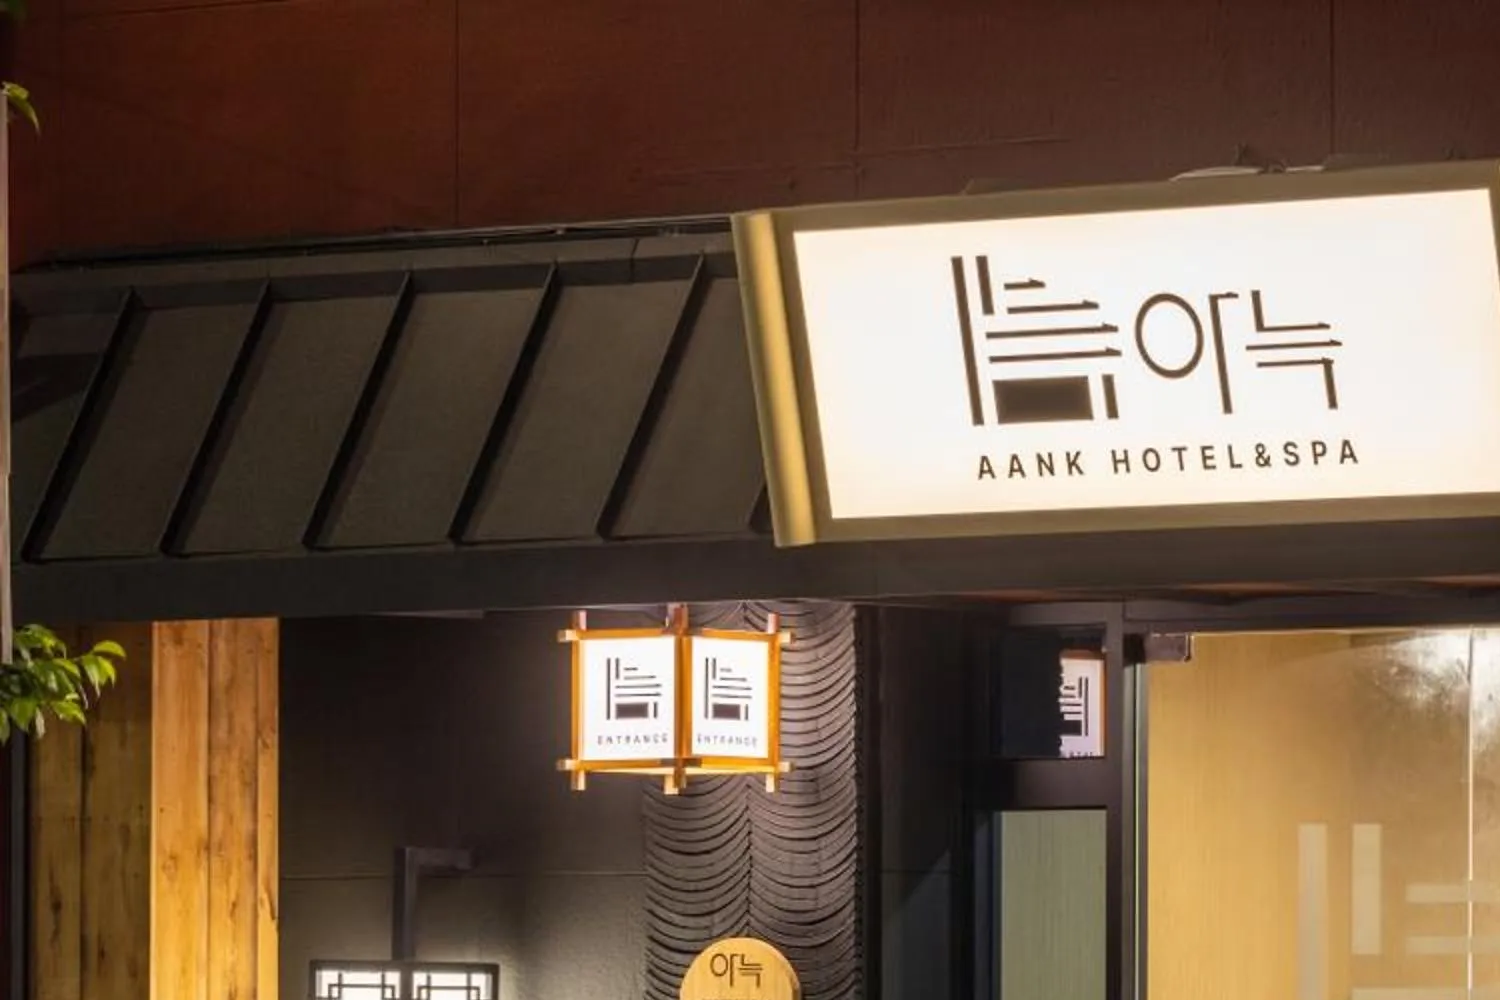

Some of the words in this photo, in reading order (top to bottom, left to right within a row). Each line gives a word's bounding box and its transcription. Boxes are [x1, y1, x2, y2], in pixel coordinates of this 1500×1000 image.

[1135, 290, 1342, 414] 아늑
[977, 450, 1084, 480] AANK
[1111, 439, 1358, 475] HOTEL&SPA
[597, 732, 669, 746] ENTRANCE
[697, 733, 758, 748] ENTRANCE
[710, 953, 763, 988] 아늑
